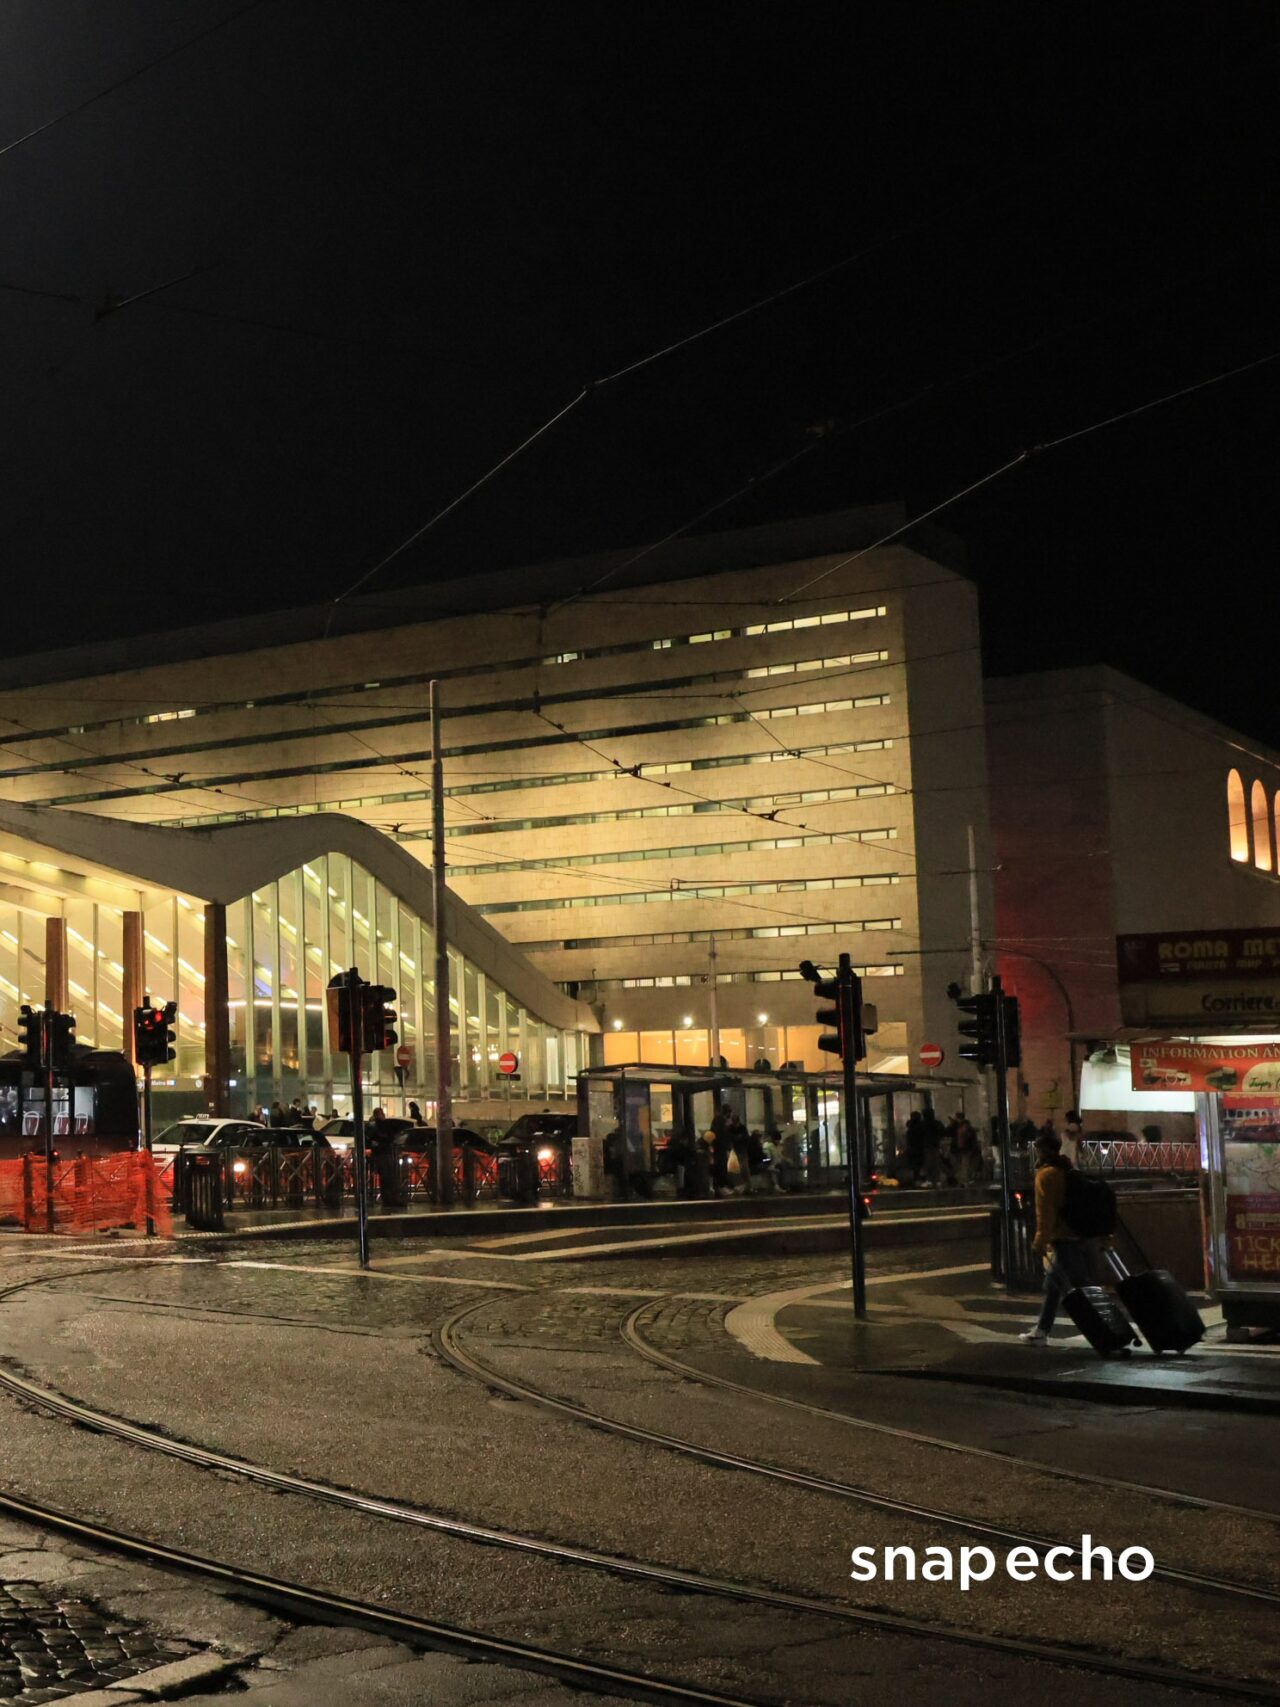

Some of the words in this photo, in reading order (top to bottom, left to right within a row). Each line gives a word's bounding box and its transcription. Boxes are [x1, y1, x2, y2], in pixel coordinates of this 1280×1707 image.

[1158, 941, 1228, 959] ROMA
[1202, 992, 1273, 1012] Corriere
[1143, 1046, 1259, 1059] INFORMATION
